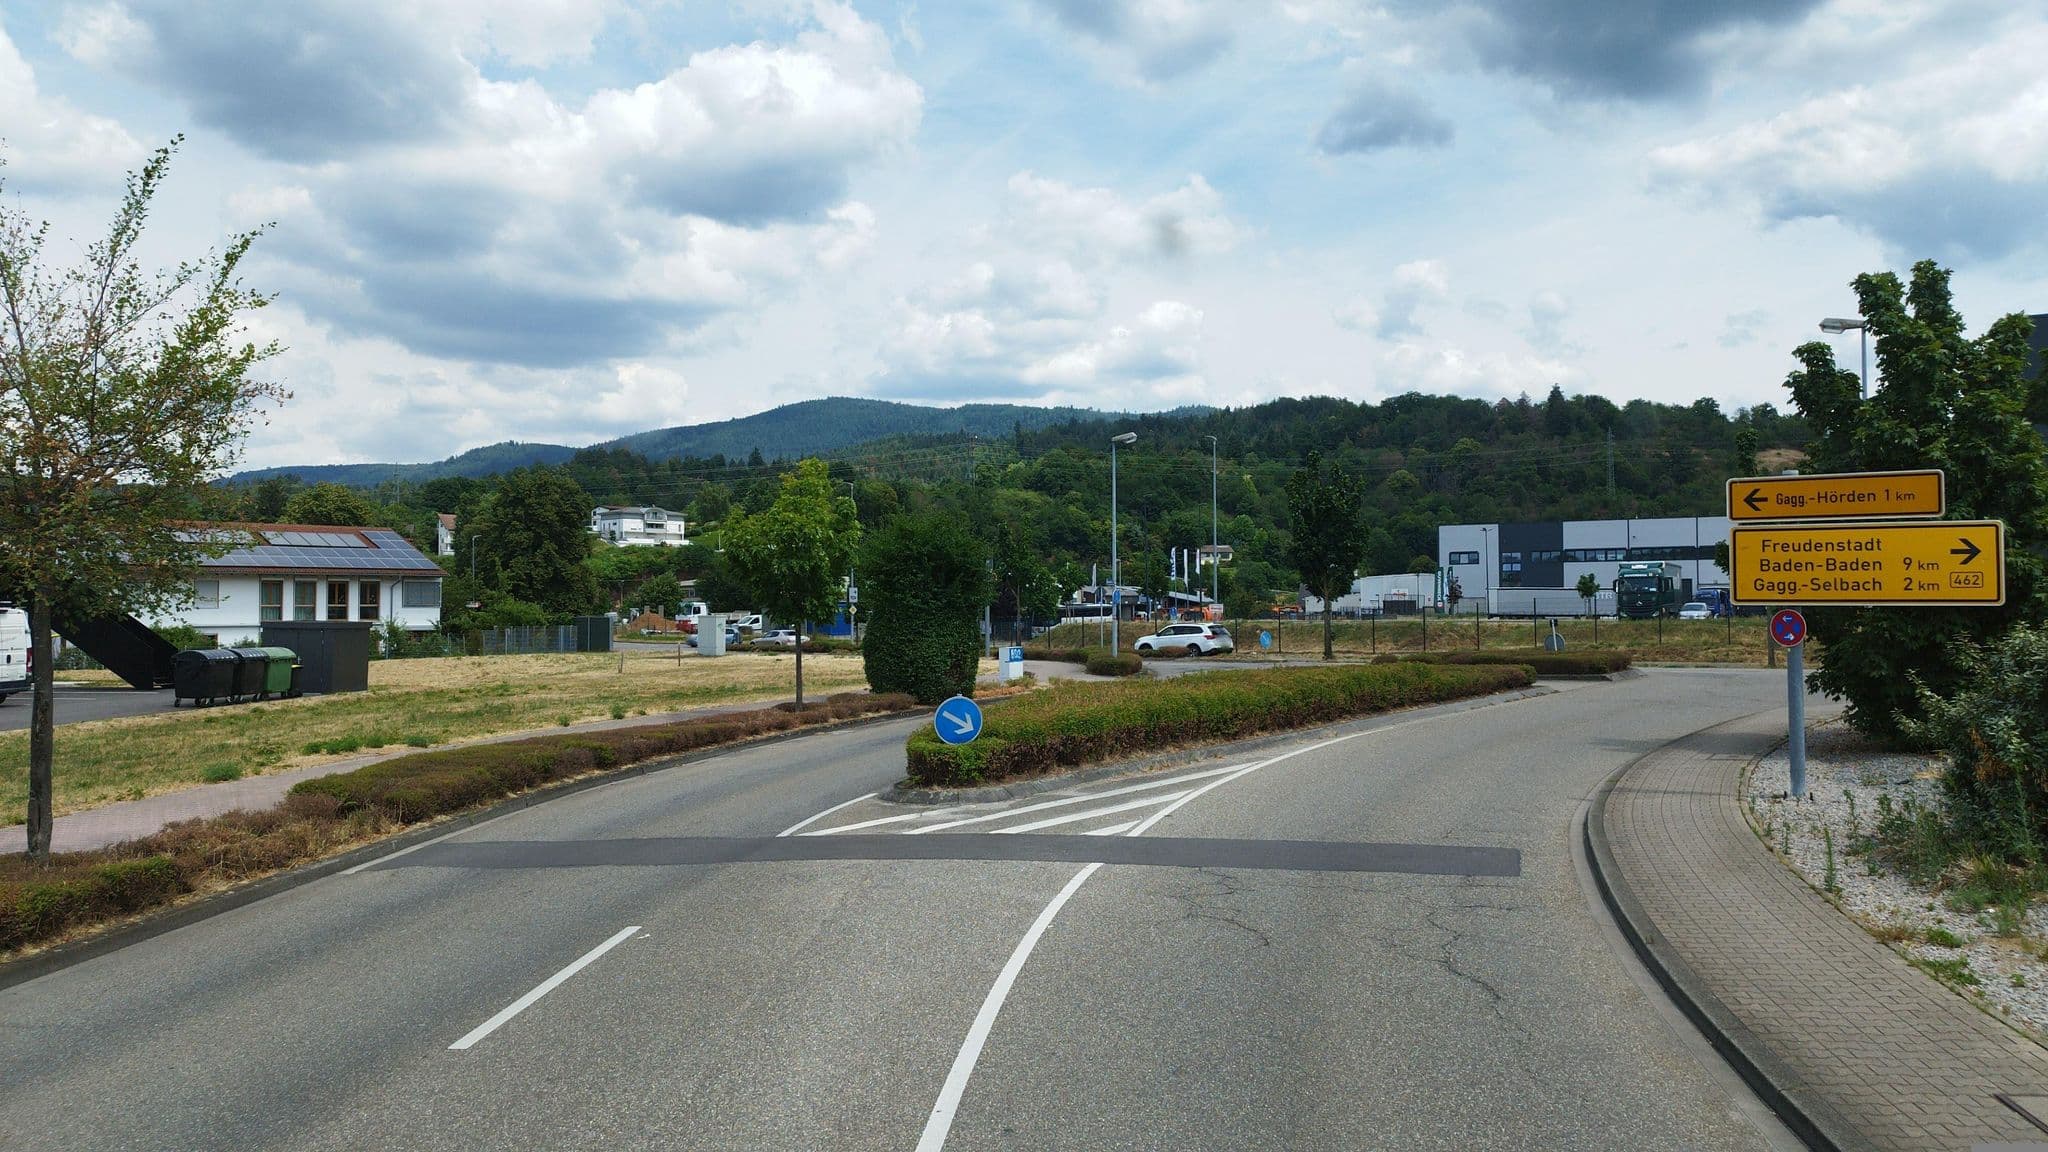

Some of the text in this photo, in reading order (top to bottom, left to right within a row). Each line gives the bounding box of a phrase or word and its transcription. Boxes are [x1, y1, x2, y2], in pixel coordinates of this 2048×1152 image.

[1776, 489, 1916, 508] Gagg.-Hörden 1 km
[1762, 538, 1882, 552] Freudenstadt
[1759, 557, 1940, 572] Baden-Baden 9 km
[1753, 577, 1940, 595] Gagg.-Selbach 2 km
[1953, 575, 1979, 586] 462
